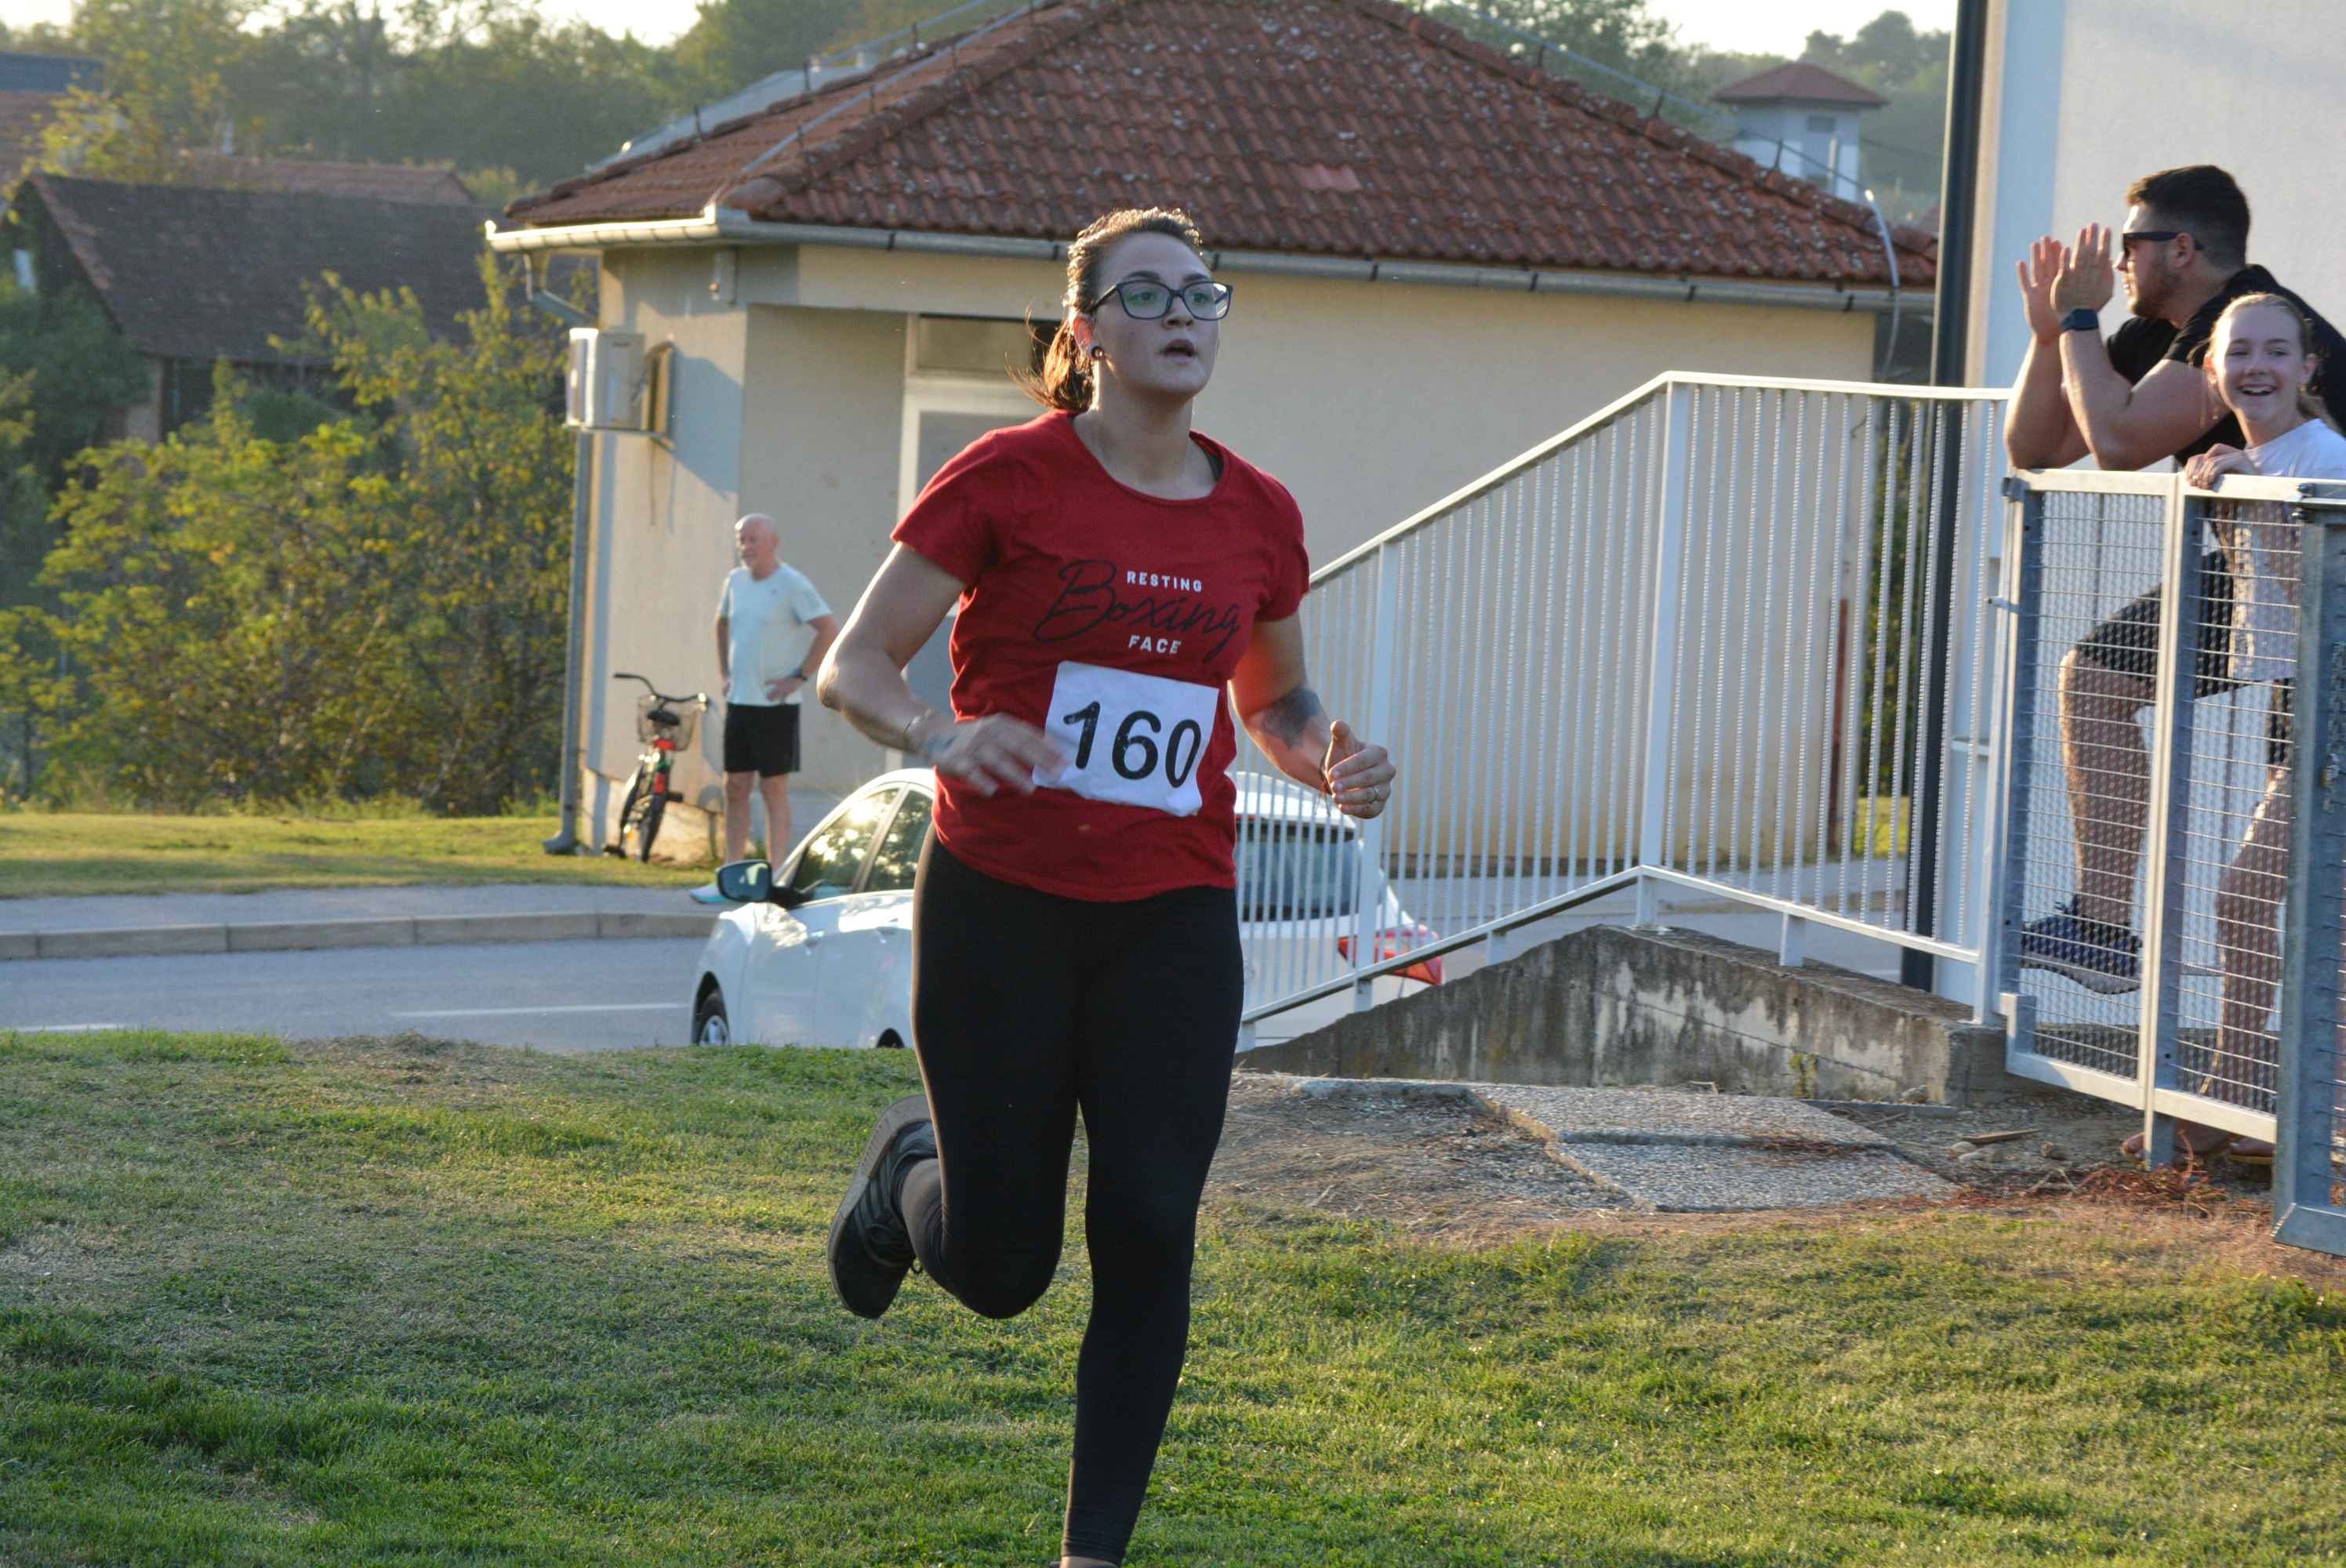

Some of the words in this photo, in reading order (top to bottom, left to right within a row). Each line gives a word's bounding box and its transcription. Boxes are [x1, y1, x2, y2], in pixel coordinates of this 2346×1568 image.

[1127, 571, 1203, 591] RESTING
[1033, 560, 1241, 662] Boxing
[1128, 635, 1182, 654] FACE
[1063, 701, 1201, 788] 160
